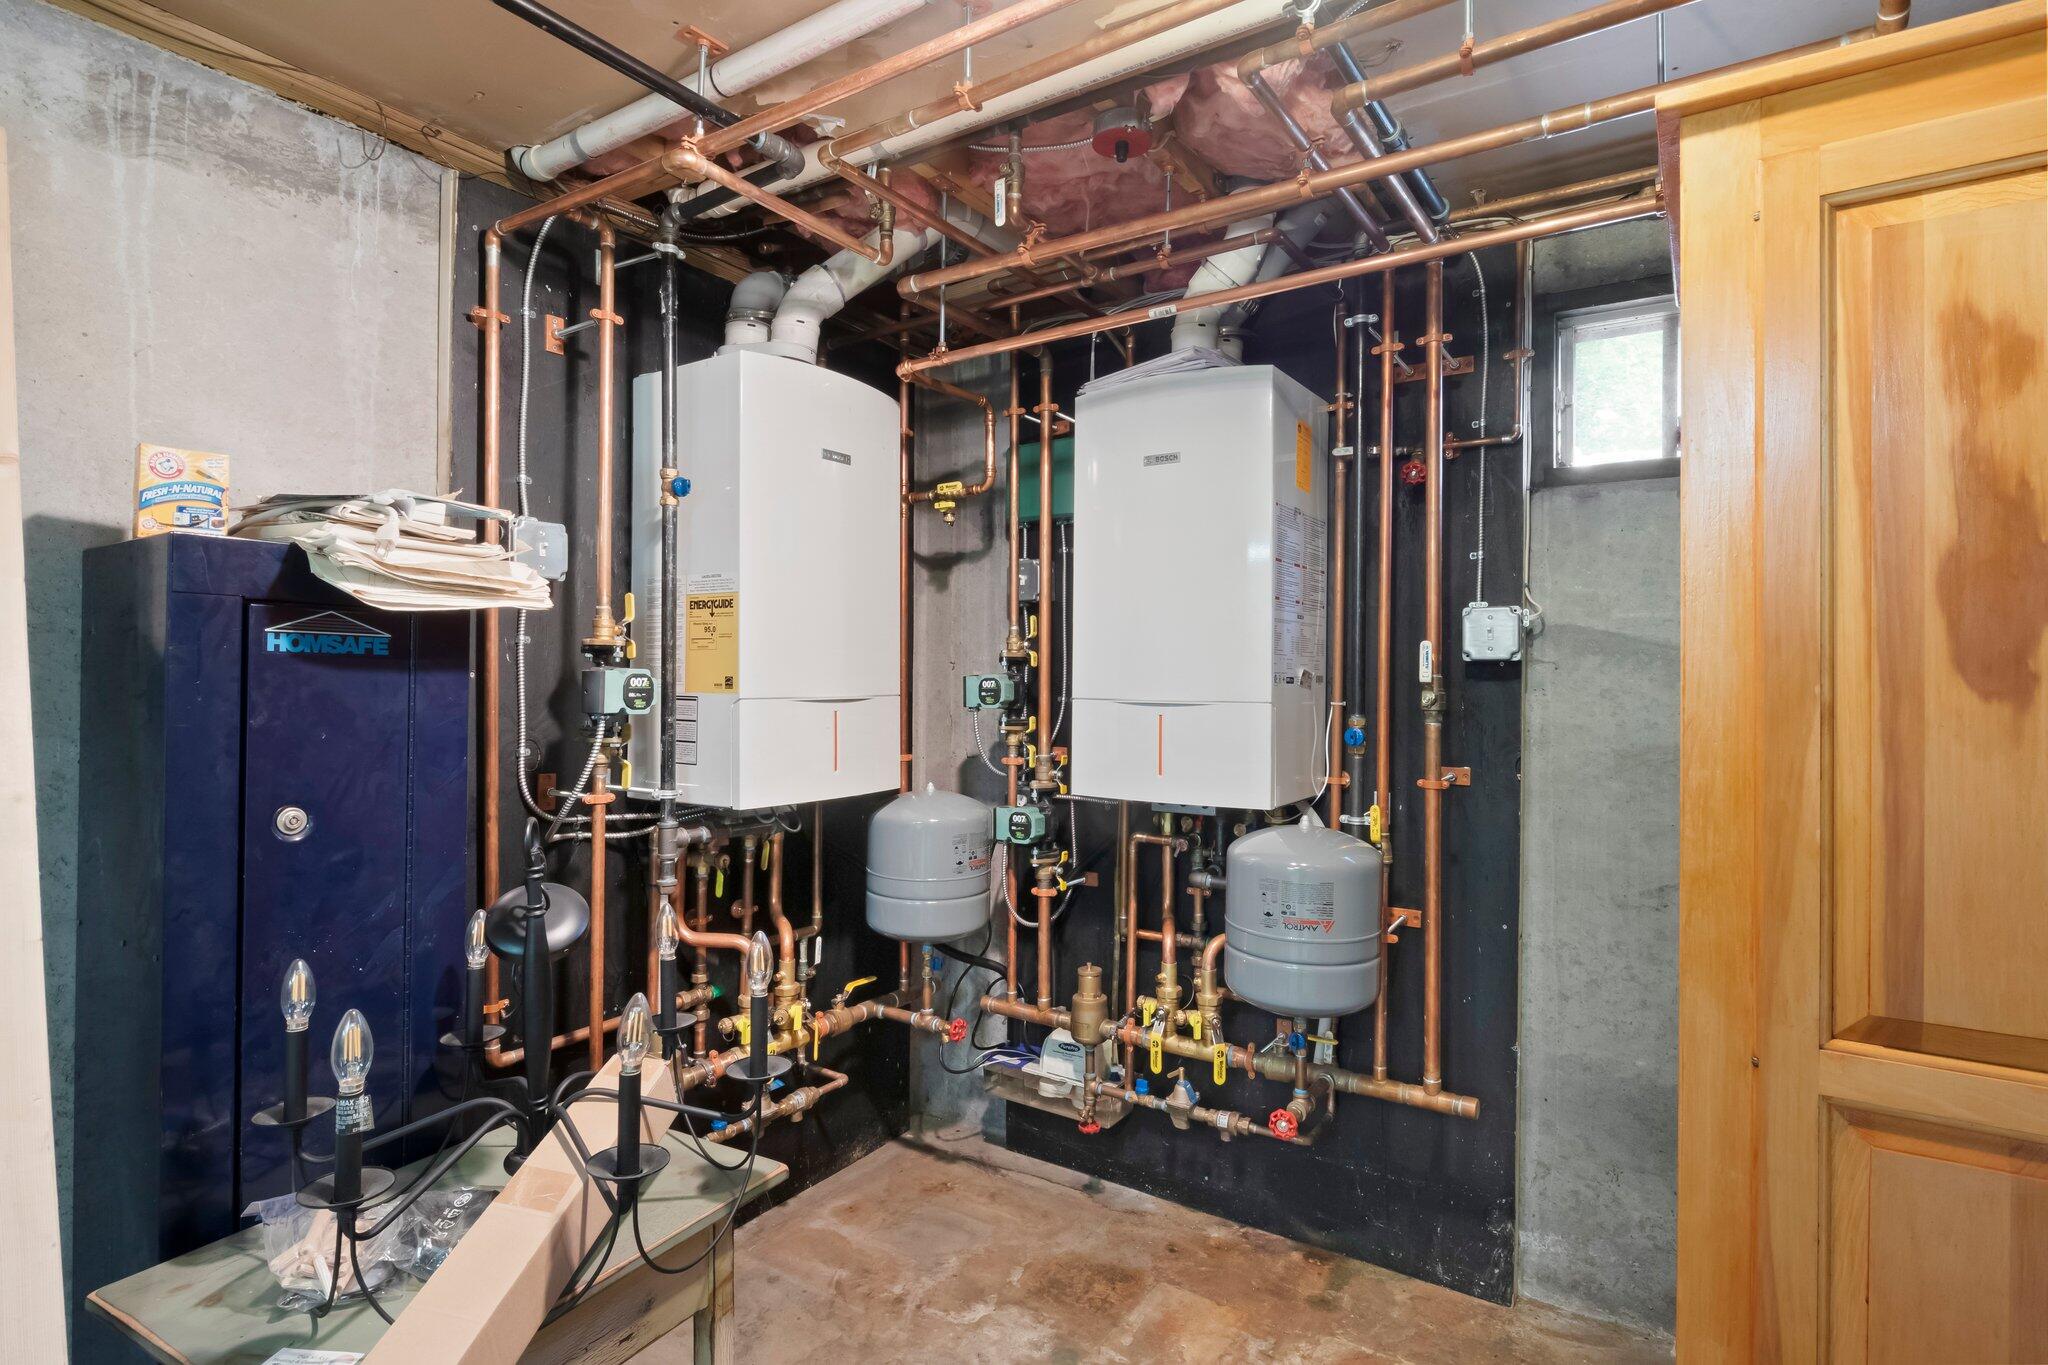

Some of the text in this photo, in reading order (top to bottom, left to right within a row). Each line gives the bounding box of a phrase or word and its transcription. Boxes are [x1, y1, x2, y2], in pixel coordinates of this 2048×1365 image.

[1155, 454, 1178, 463] BOSCH
[266, 632, 390, 655] HOMSAFE
[1283, 922, 1319, 932] AMTROL
